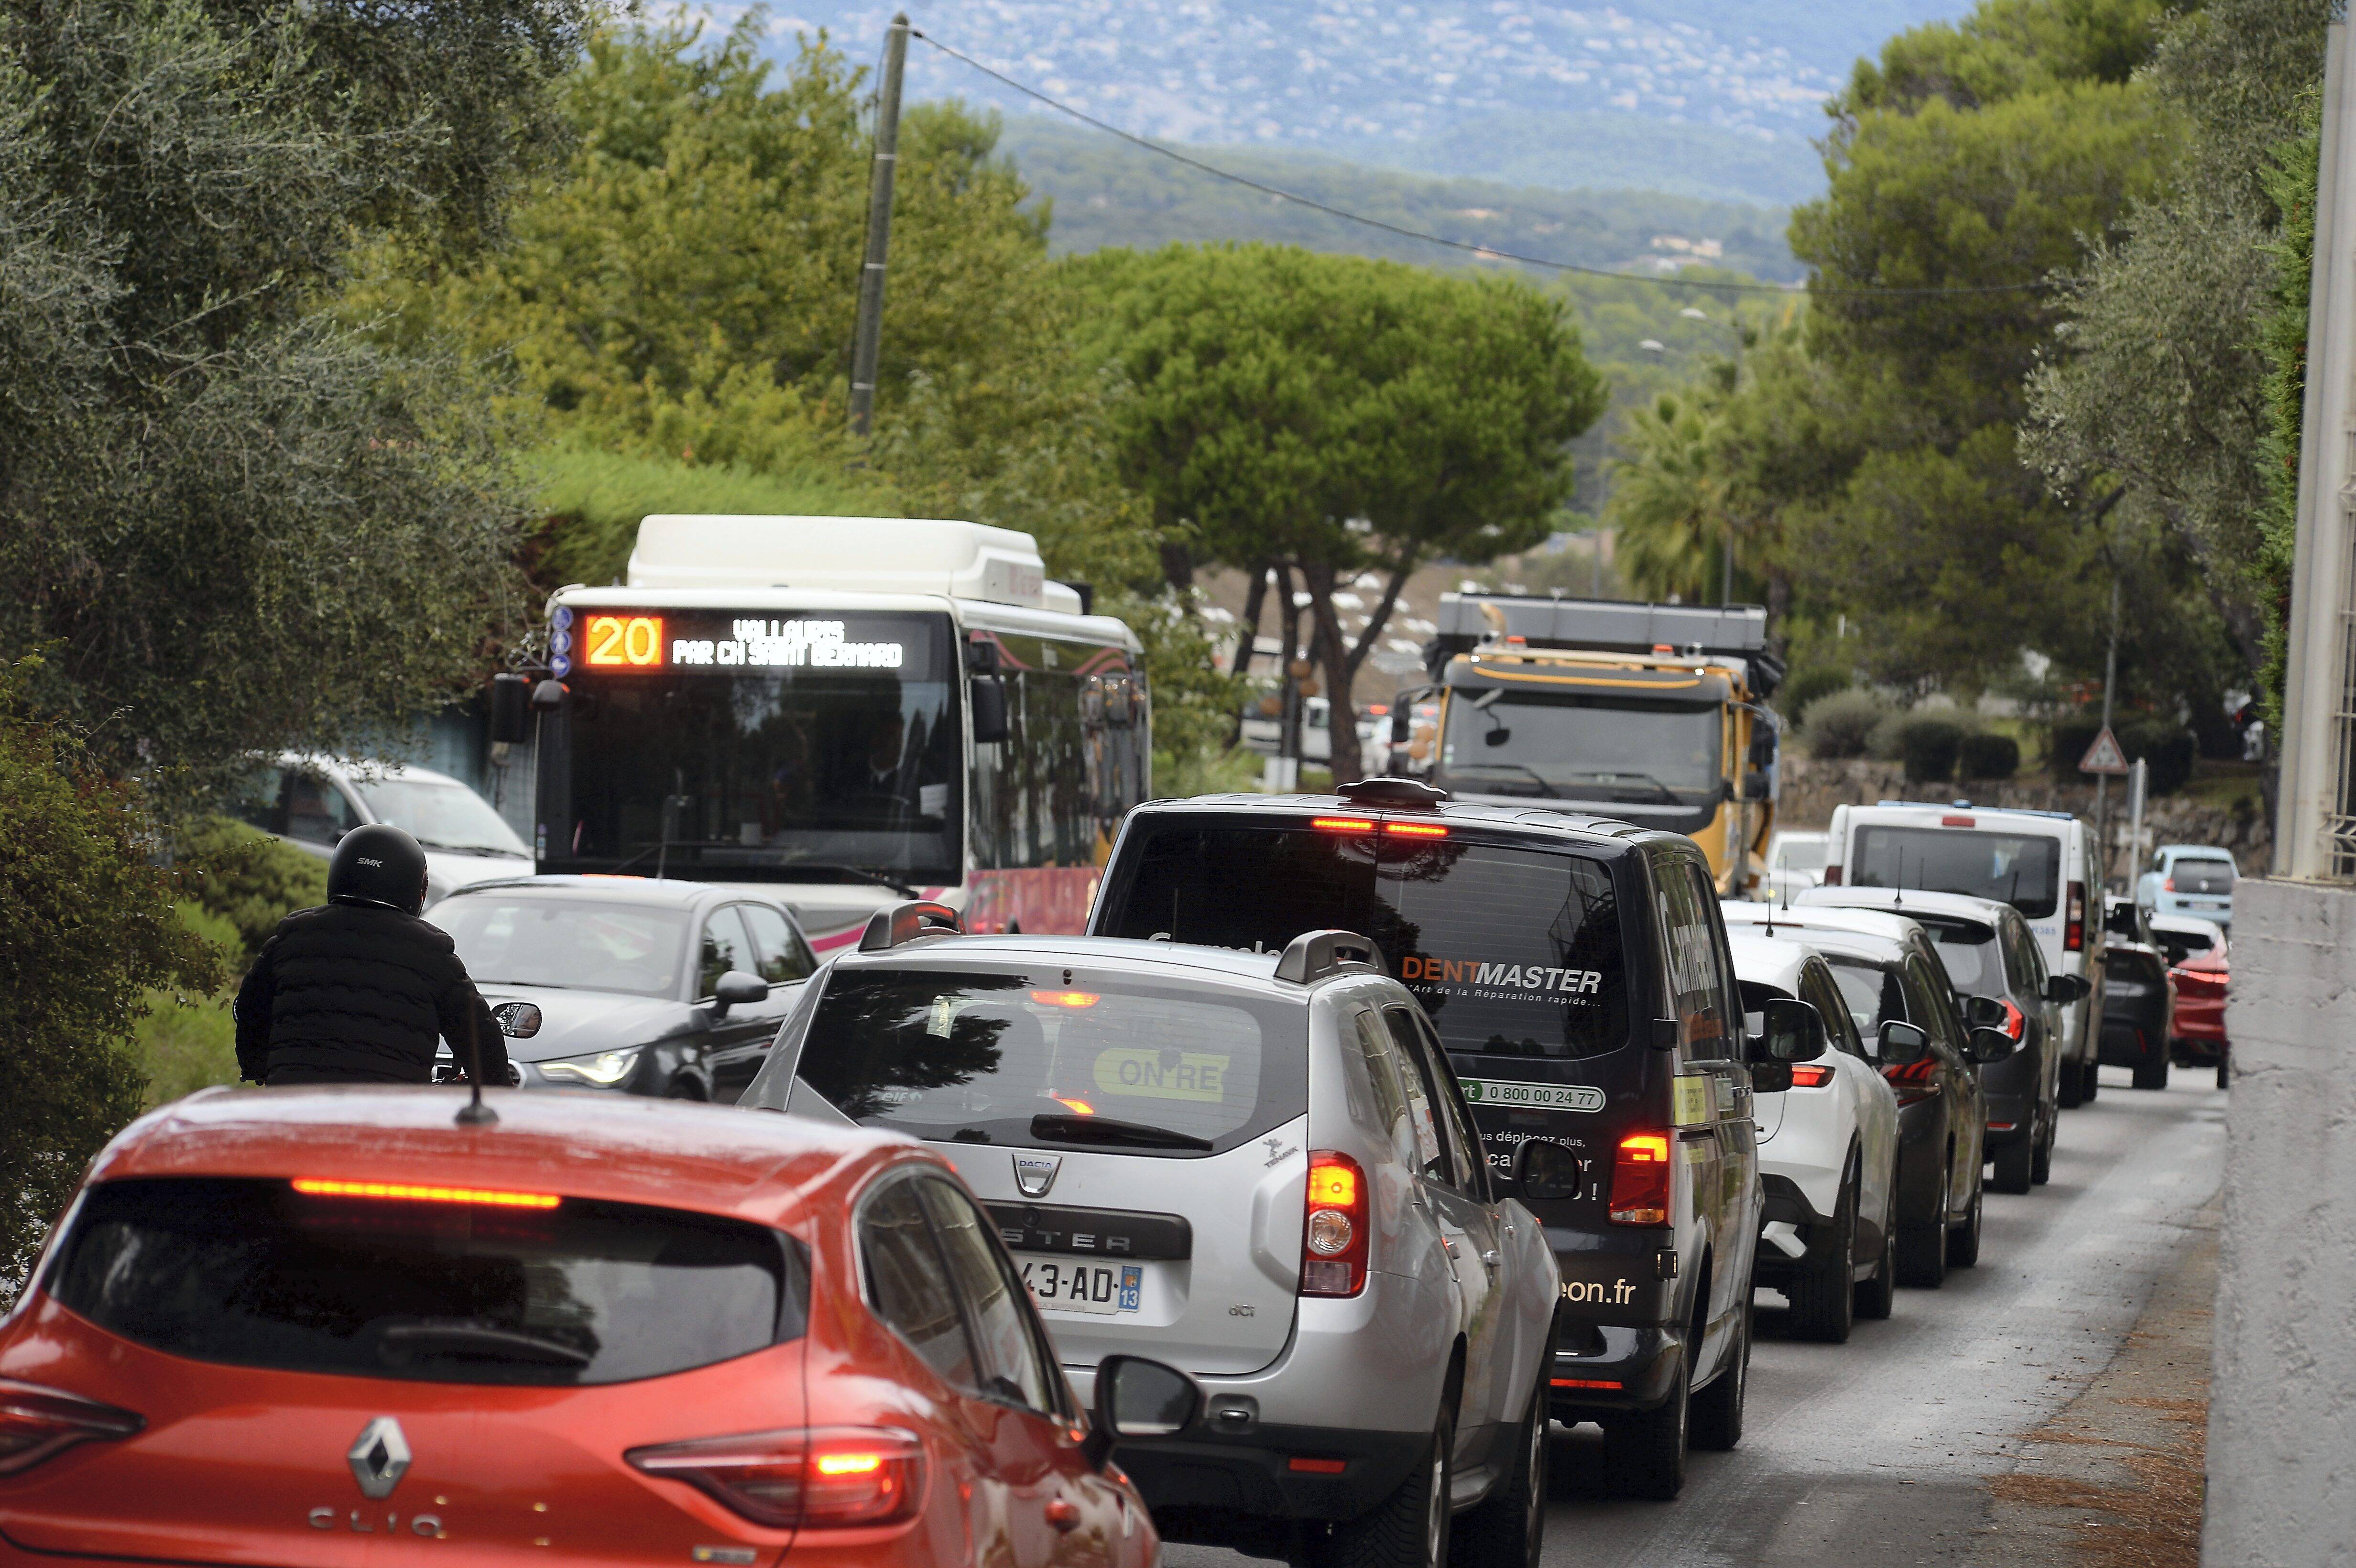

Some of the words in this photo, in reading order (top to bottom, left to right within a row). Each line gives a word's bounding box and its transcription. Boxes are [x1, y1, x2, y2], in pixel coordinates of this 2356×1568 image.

[589, 617, 658, 664] 20
[673, 640, 714, 664] PAR
[357, 858, 382, 868] SMK
[1402, 957, 1602, 993] DENTMASTER
[1402, 984, 1431, 993] 'Art
[1437, 986, 1451, 995] de
[1457, 988, 1468, 996] la
[1474, 989, 1542, 1001] Réparation
[1119, 1059, 1164, 1087] ON
[1490, 1086, 1498, 1099] 0
[1503, 1087, 1529, 1100] 800
[1534, 1089, 1551, 1102] 00
[1556, 1091, 1573, 1103] 24
[1578, 1092, 1595, 1105] 77
[1001, 1228, 1131, 1251] STER
[1121, 1289, 1138, 1307] 13
[308, 1506, 441, 1536] CLIO
